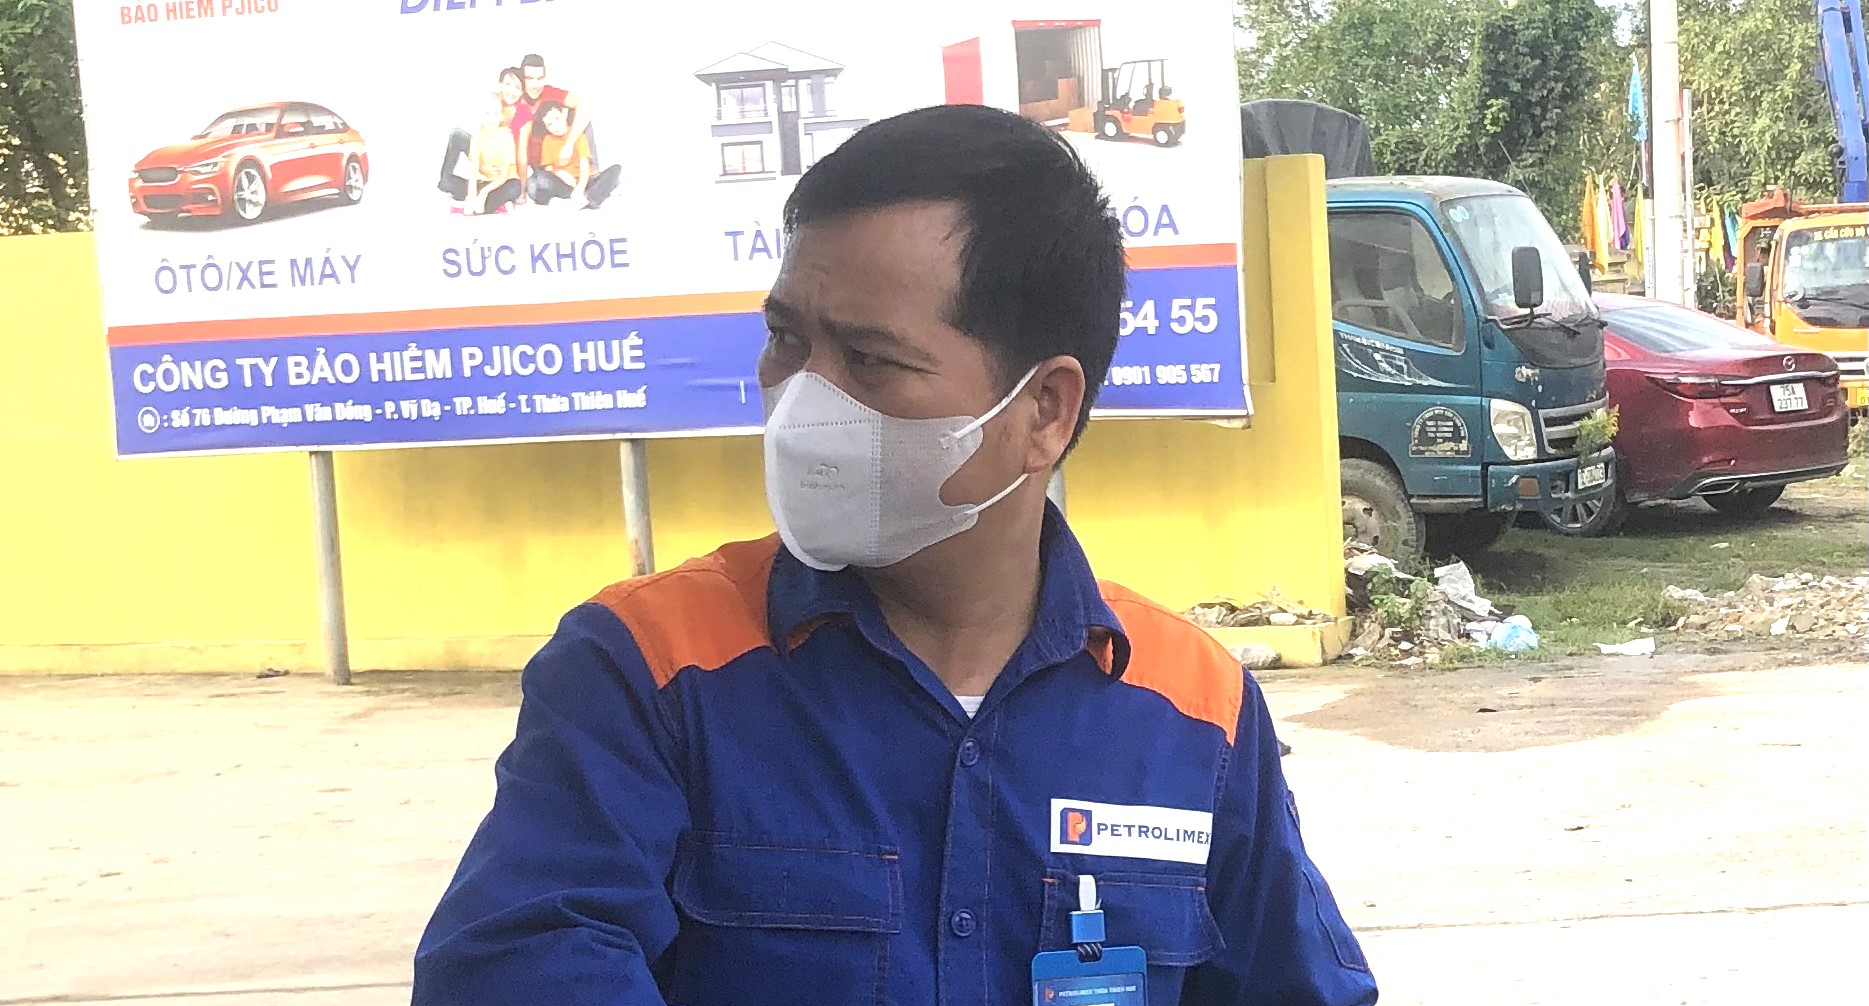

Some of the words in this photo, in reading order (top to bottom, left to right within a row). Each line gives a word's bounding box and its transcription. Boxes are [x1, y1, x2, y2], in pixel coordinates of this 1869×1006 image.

[442, 238, 516, 278] SỨC
[529, 232, 630, 274] KHỎE
[724, 221, 782, 261] TÀI
[155, 255, 278, 294] ÔTÔ/XE
[290, 248, 362, 287] MÁY
[1170, 297, 1218, 334] 55
[133, 354, 229, 394] CÔNG
[235, 357, 278, 387] TY
[287, 347, 361, 386] BẢO
[369, 342, 452, 382] HIỂM
[461, 343, 564, 377] PJICO
[572, 331, 646, 373] HUẾ
[1112, 366, 1151, 385] 0901
[1156, 364, 1186, 384] 905
[1190, 363, 1220, 383] 567
[171, 406, 191, 428] Số
[193, 408, 211, 427] 76
[260, 405, 302, 427] Phạm
[453, 396, 475, 415] TP.
[1096, 822, 1211, 845] PETROLIMEX
